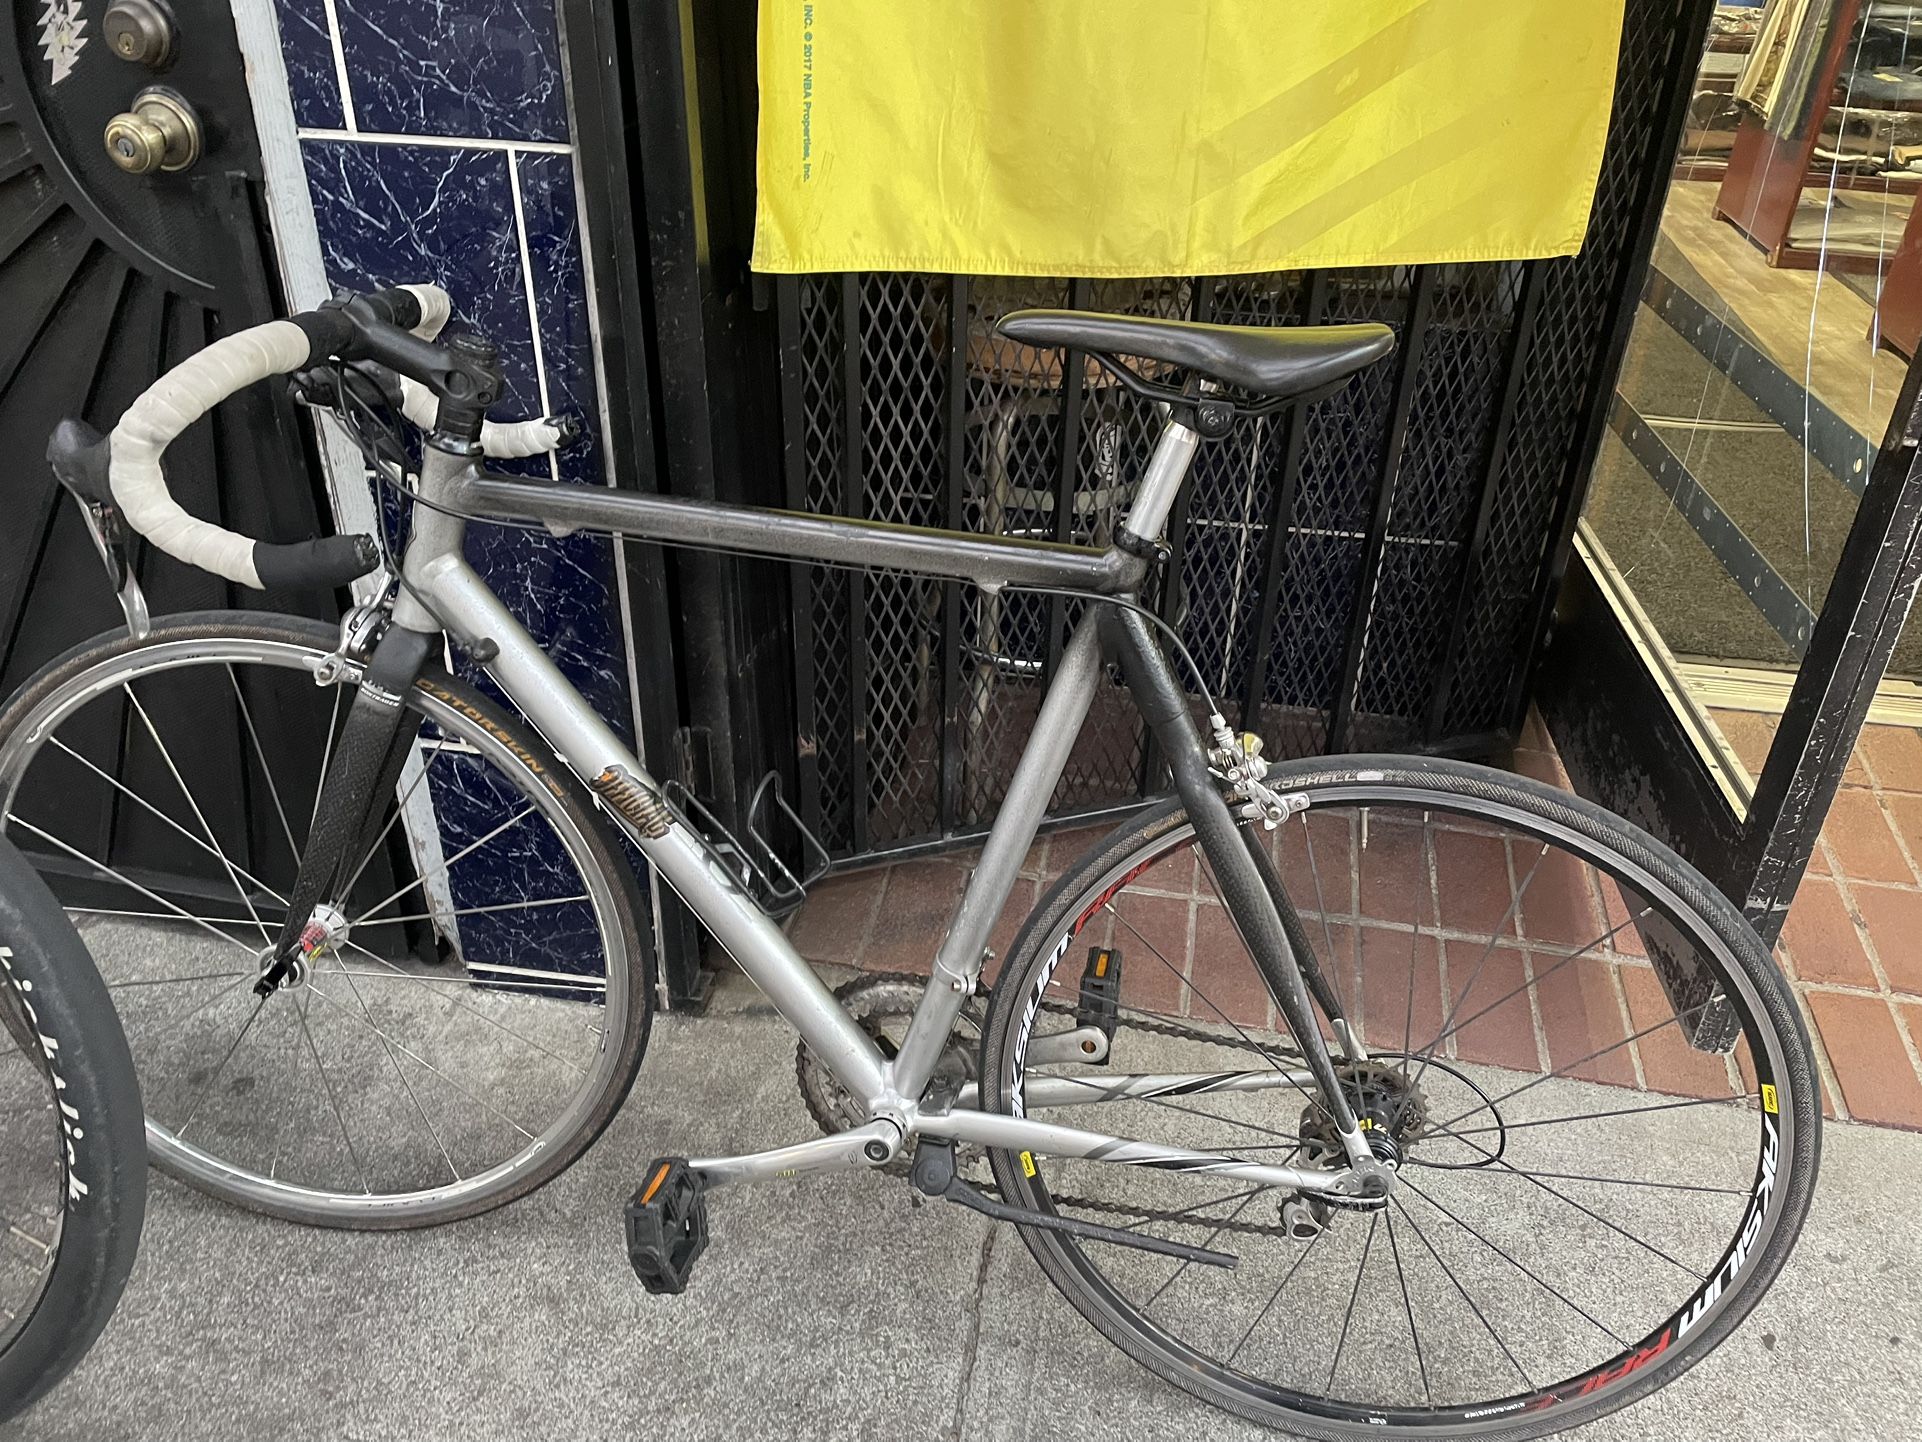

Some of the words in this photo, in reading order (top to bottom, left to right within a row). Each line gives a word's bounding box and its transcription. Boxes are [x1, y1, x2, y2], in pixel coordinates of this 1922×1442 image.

[803, 5, 813, 29] INC.
[803, 44, 813, 70] 2017
[803, 73, 812, 99] NBA
[801, 101, 812, 161] Properties,
[803, 163, 812, 183] Inc.
[1676, 1112, 1779, 1340] AKSIUM
